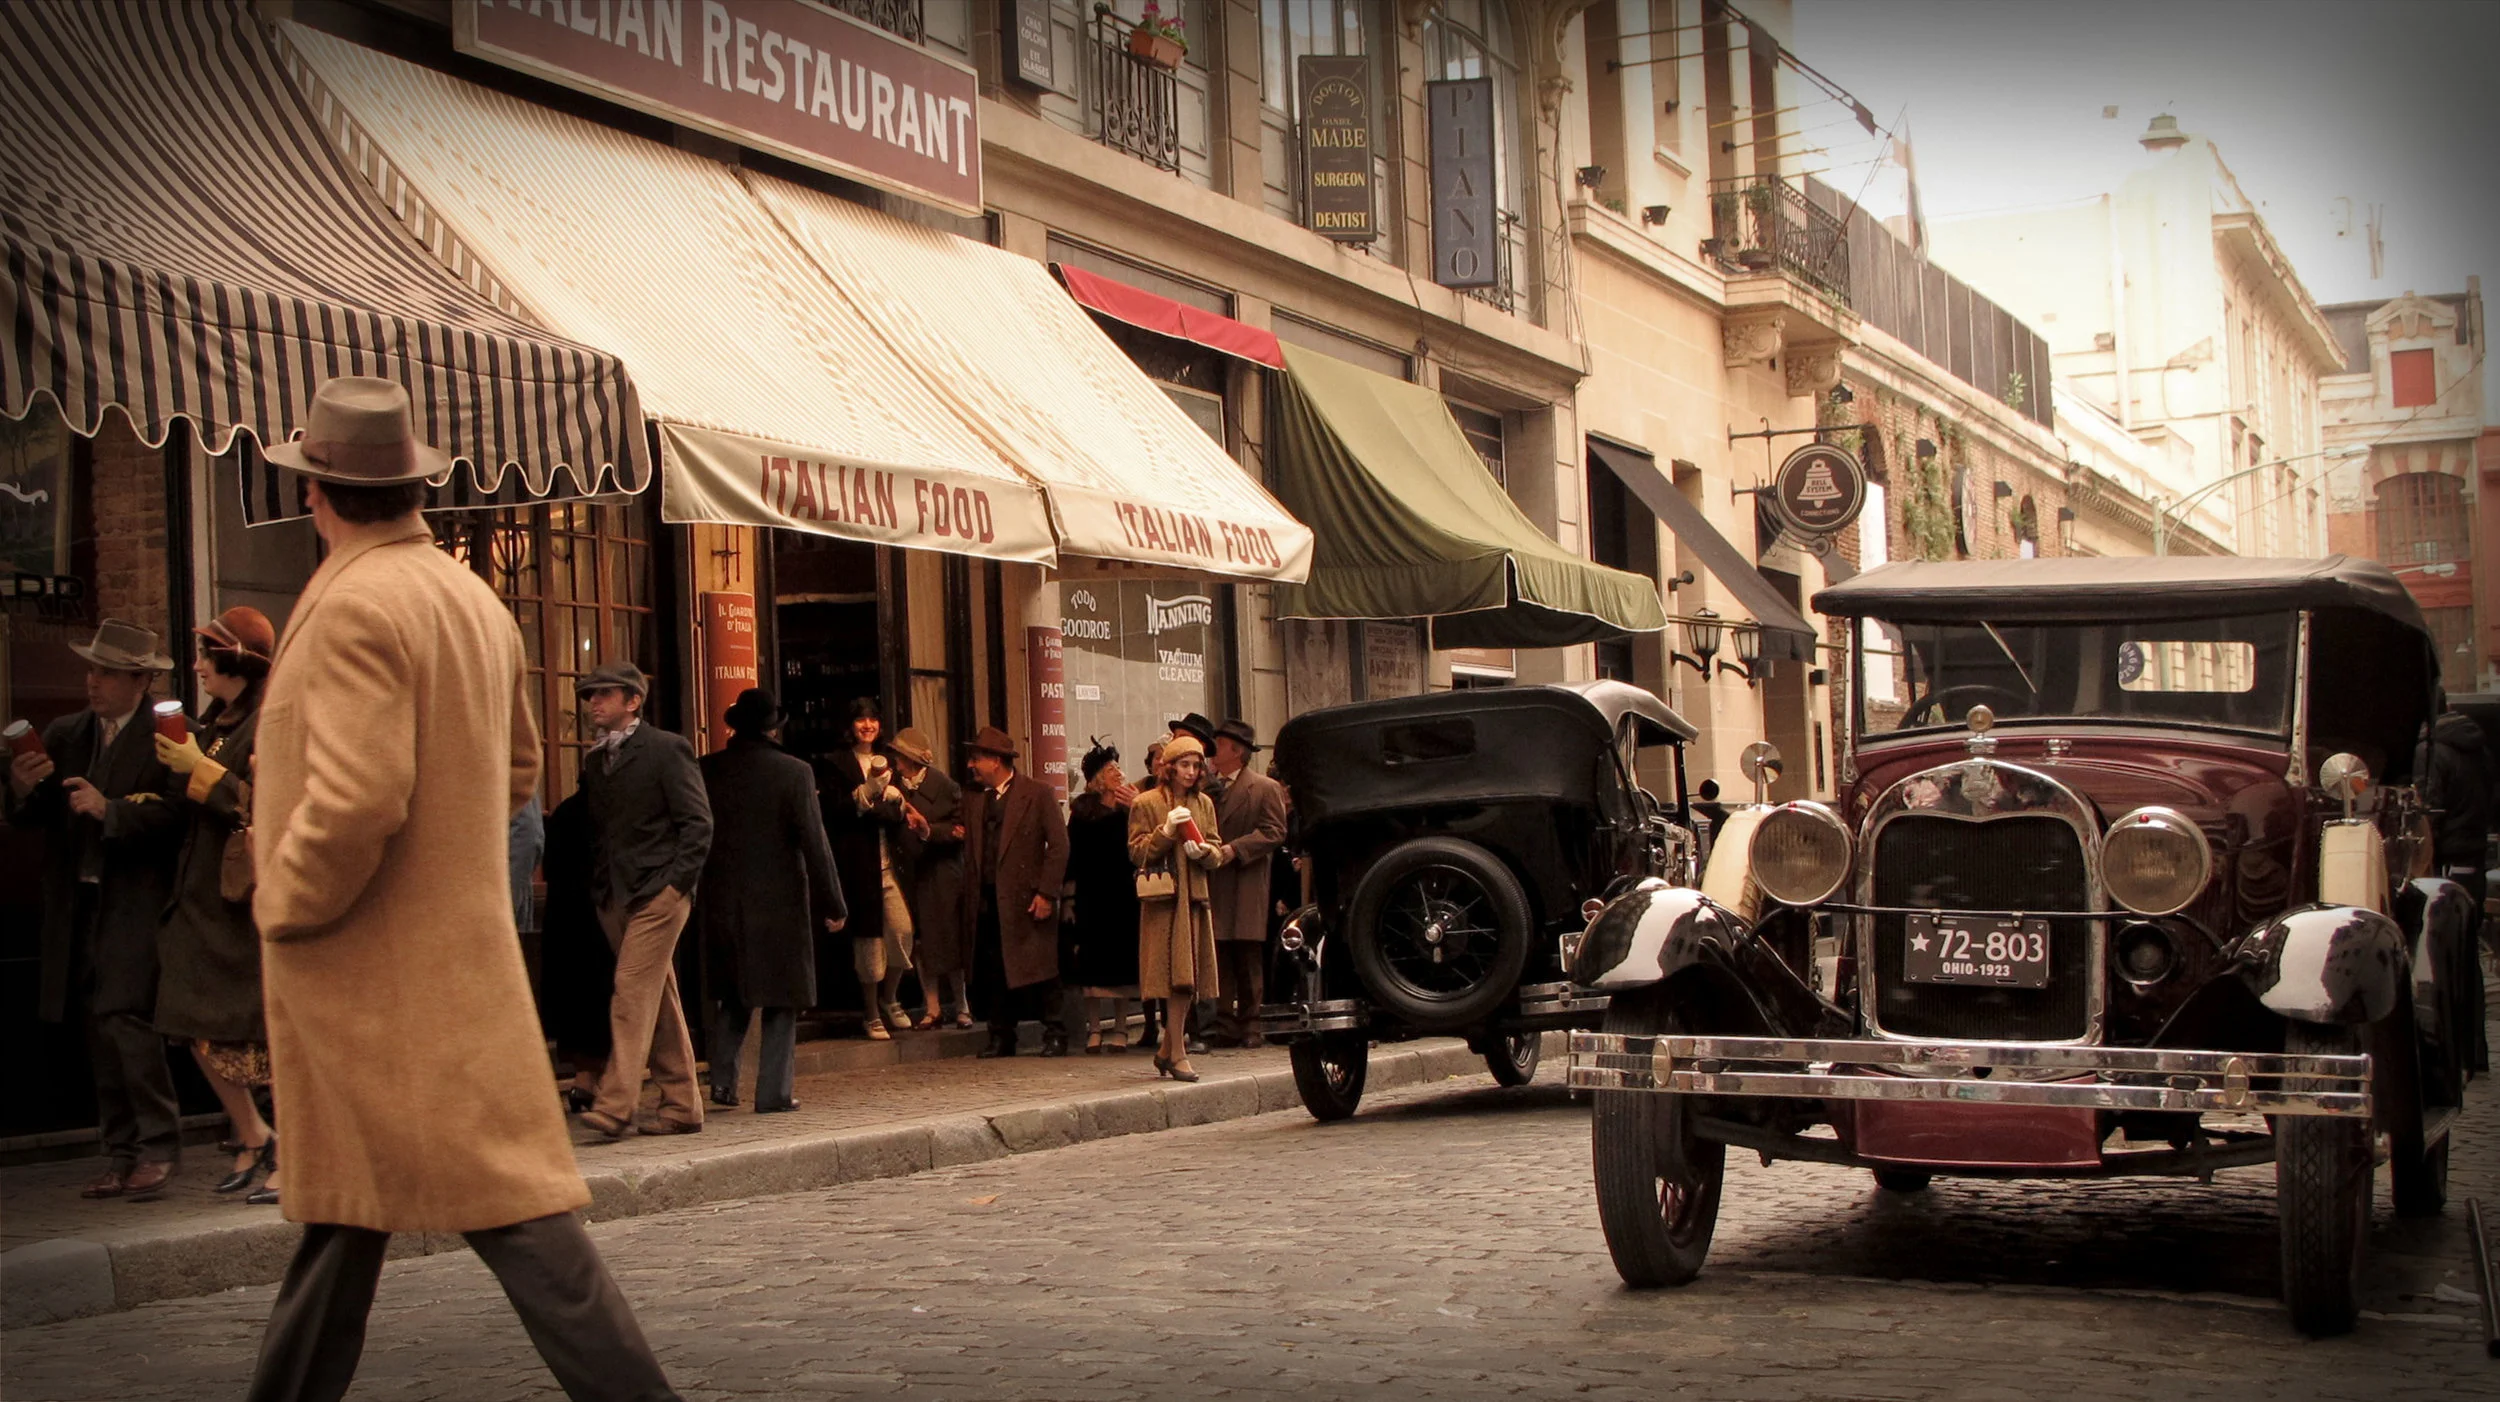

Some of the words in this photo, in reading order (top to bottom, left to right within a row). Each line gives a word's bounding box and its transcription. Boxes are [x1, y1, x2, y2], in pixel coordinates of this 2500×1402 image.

[702, 5, 972, 176] RESTAURANT
[1312, 82, 1361, 108] DOCTOR
[1321, 117, 1353, 126] DANIEL
[1311, 127, 1367, 148] MABE
[1314, 171, 1367, 188] SURGEON
[1447, 86, 1482, 280] PIANO
[1315, 211, 1367, 228] DENTIST
[1806, 485, 1833, 494] SYSTEM
[1811, 479, 1828, 487] BELL
[761, 455, 898, 530] ITALIAN
[914, 478, 995, 544] FOOD
[1113, 500, 1215, 560] ITALIAN
[1217, 520, 1282, 569] FOOD
[718, 603, 727, 617] IL
[1070, 589, 1097, 612] TODD
[1145, 593, 1212, 635] MANNING
[1060, 617, 1111, 640] GOODROE
[1158, 649, 1204, 668] VACUUM
[714, 665, 746, 680] ITALIAN
[1158, 666, 1205, 683] CLEANER
[1937, 929, 2044, 963] 72-803
[1942, 962, 2011, 977] OHIO-1923
